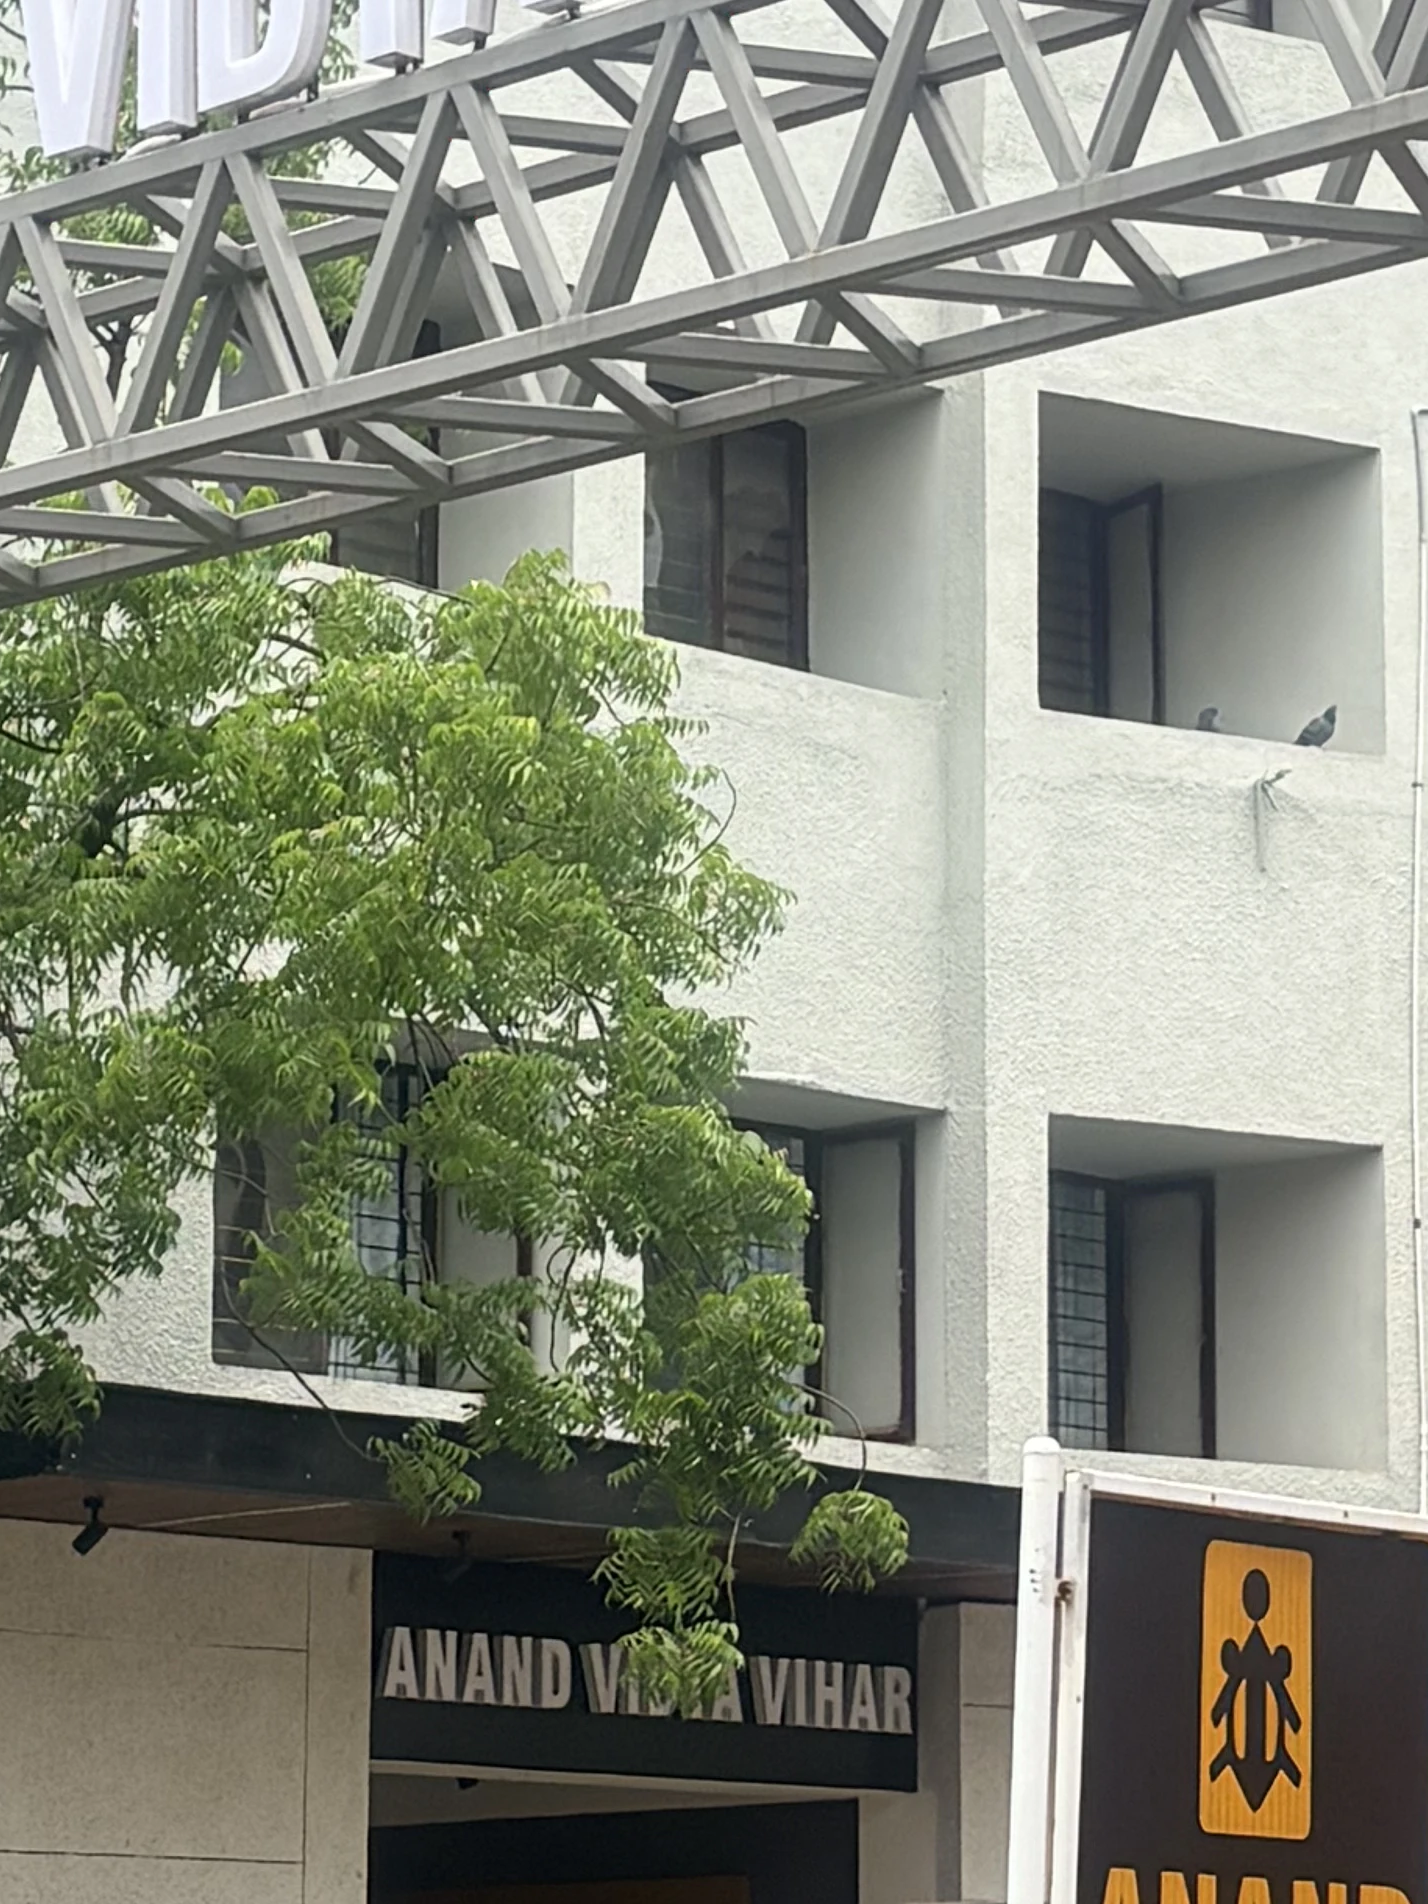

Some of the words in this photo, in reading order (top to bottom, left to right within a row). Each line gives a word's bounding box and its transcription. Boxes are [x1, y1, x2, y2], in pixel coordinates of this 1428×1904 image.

[381, 1626, 571, 1710] ANAND
[578, 1642, 744, 1724] VIA
[749, 1655, 913, 1735] VIHAR
